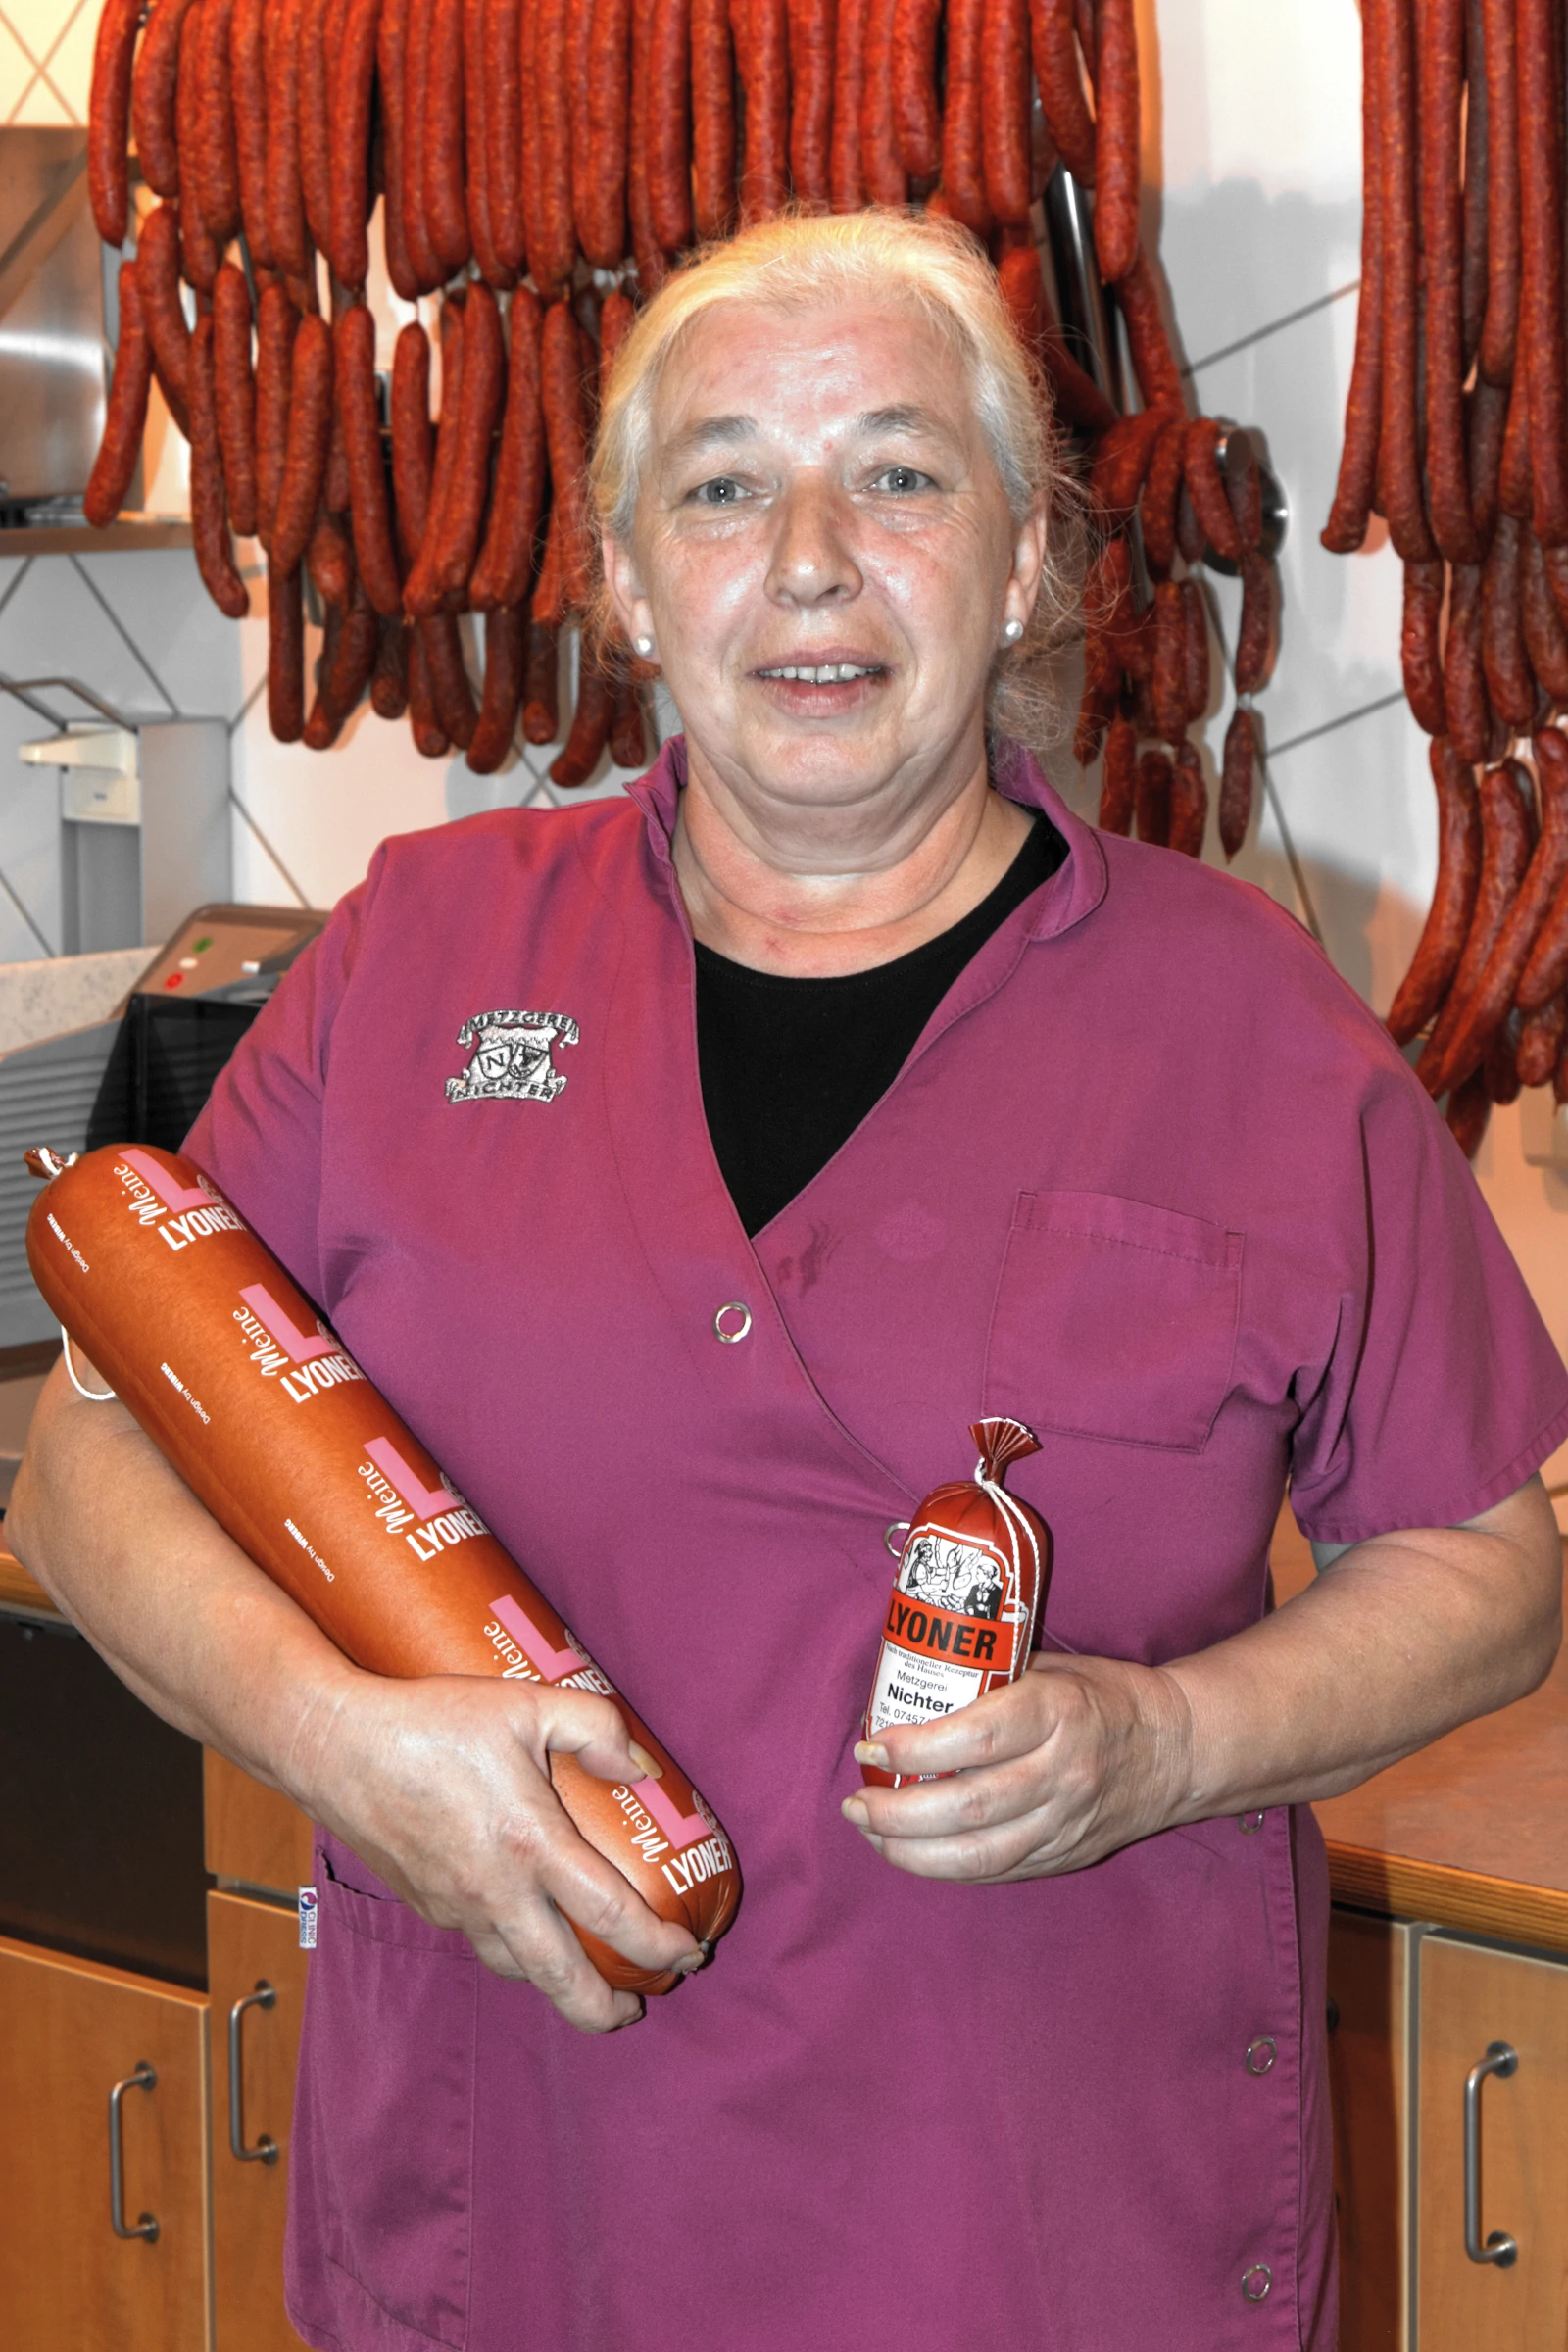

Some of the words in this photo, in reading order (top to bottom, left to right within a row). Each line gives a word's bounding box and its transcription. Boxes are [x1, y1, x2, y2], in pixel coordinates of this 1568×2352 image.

[486, 1053, 505, 1070] N
[455, 1080, 555, 1100] NICHTER
[113, 1164, 168, 1225] Meine
[232, 1306, 289, 1376] Meine
[358, 1462, 415, 1534] Meine
[886, 1600, 998, 1660] LYONER
[885, 1642, 898, 1655] Nach
[898, 1651, 942, 1670] traditioneller
[944, 1665, 979, 1679] Rezeptur
[904, 1660, 915, 1669] des
[917, 1663, 945, 1678] Hauses
[887, 1683, 954, 1713] Nichter
[897, 1670, 948, 1691] Metzgerei
[879, 1702, 891, 1716] Tel.
[894, 1709, 925, 1725] 07457
[612, 1786, 668, 1862] Meine
[662, 1838, 732, 1895] LYONER
[308, 1911, 317, 1944] CLINIC
